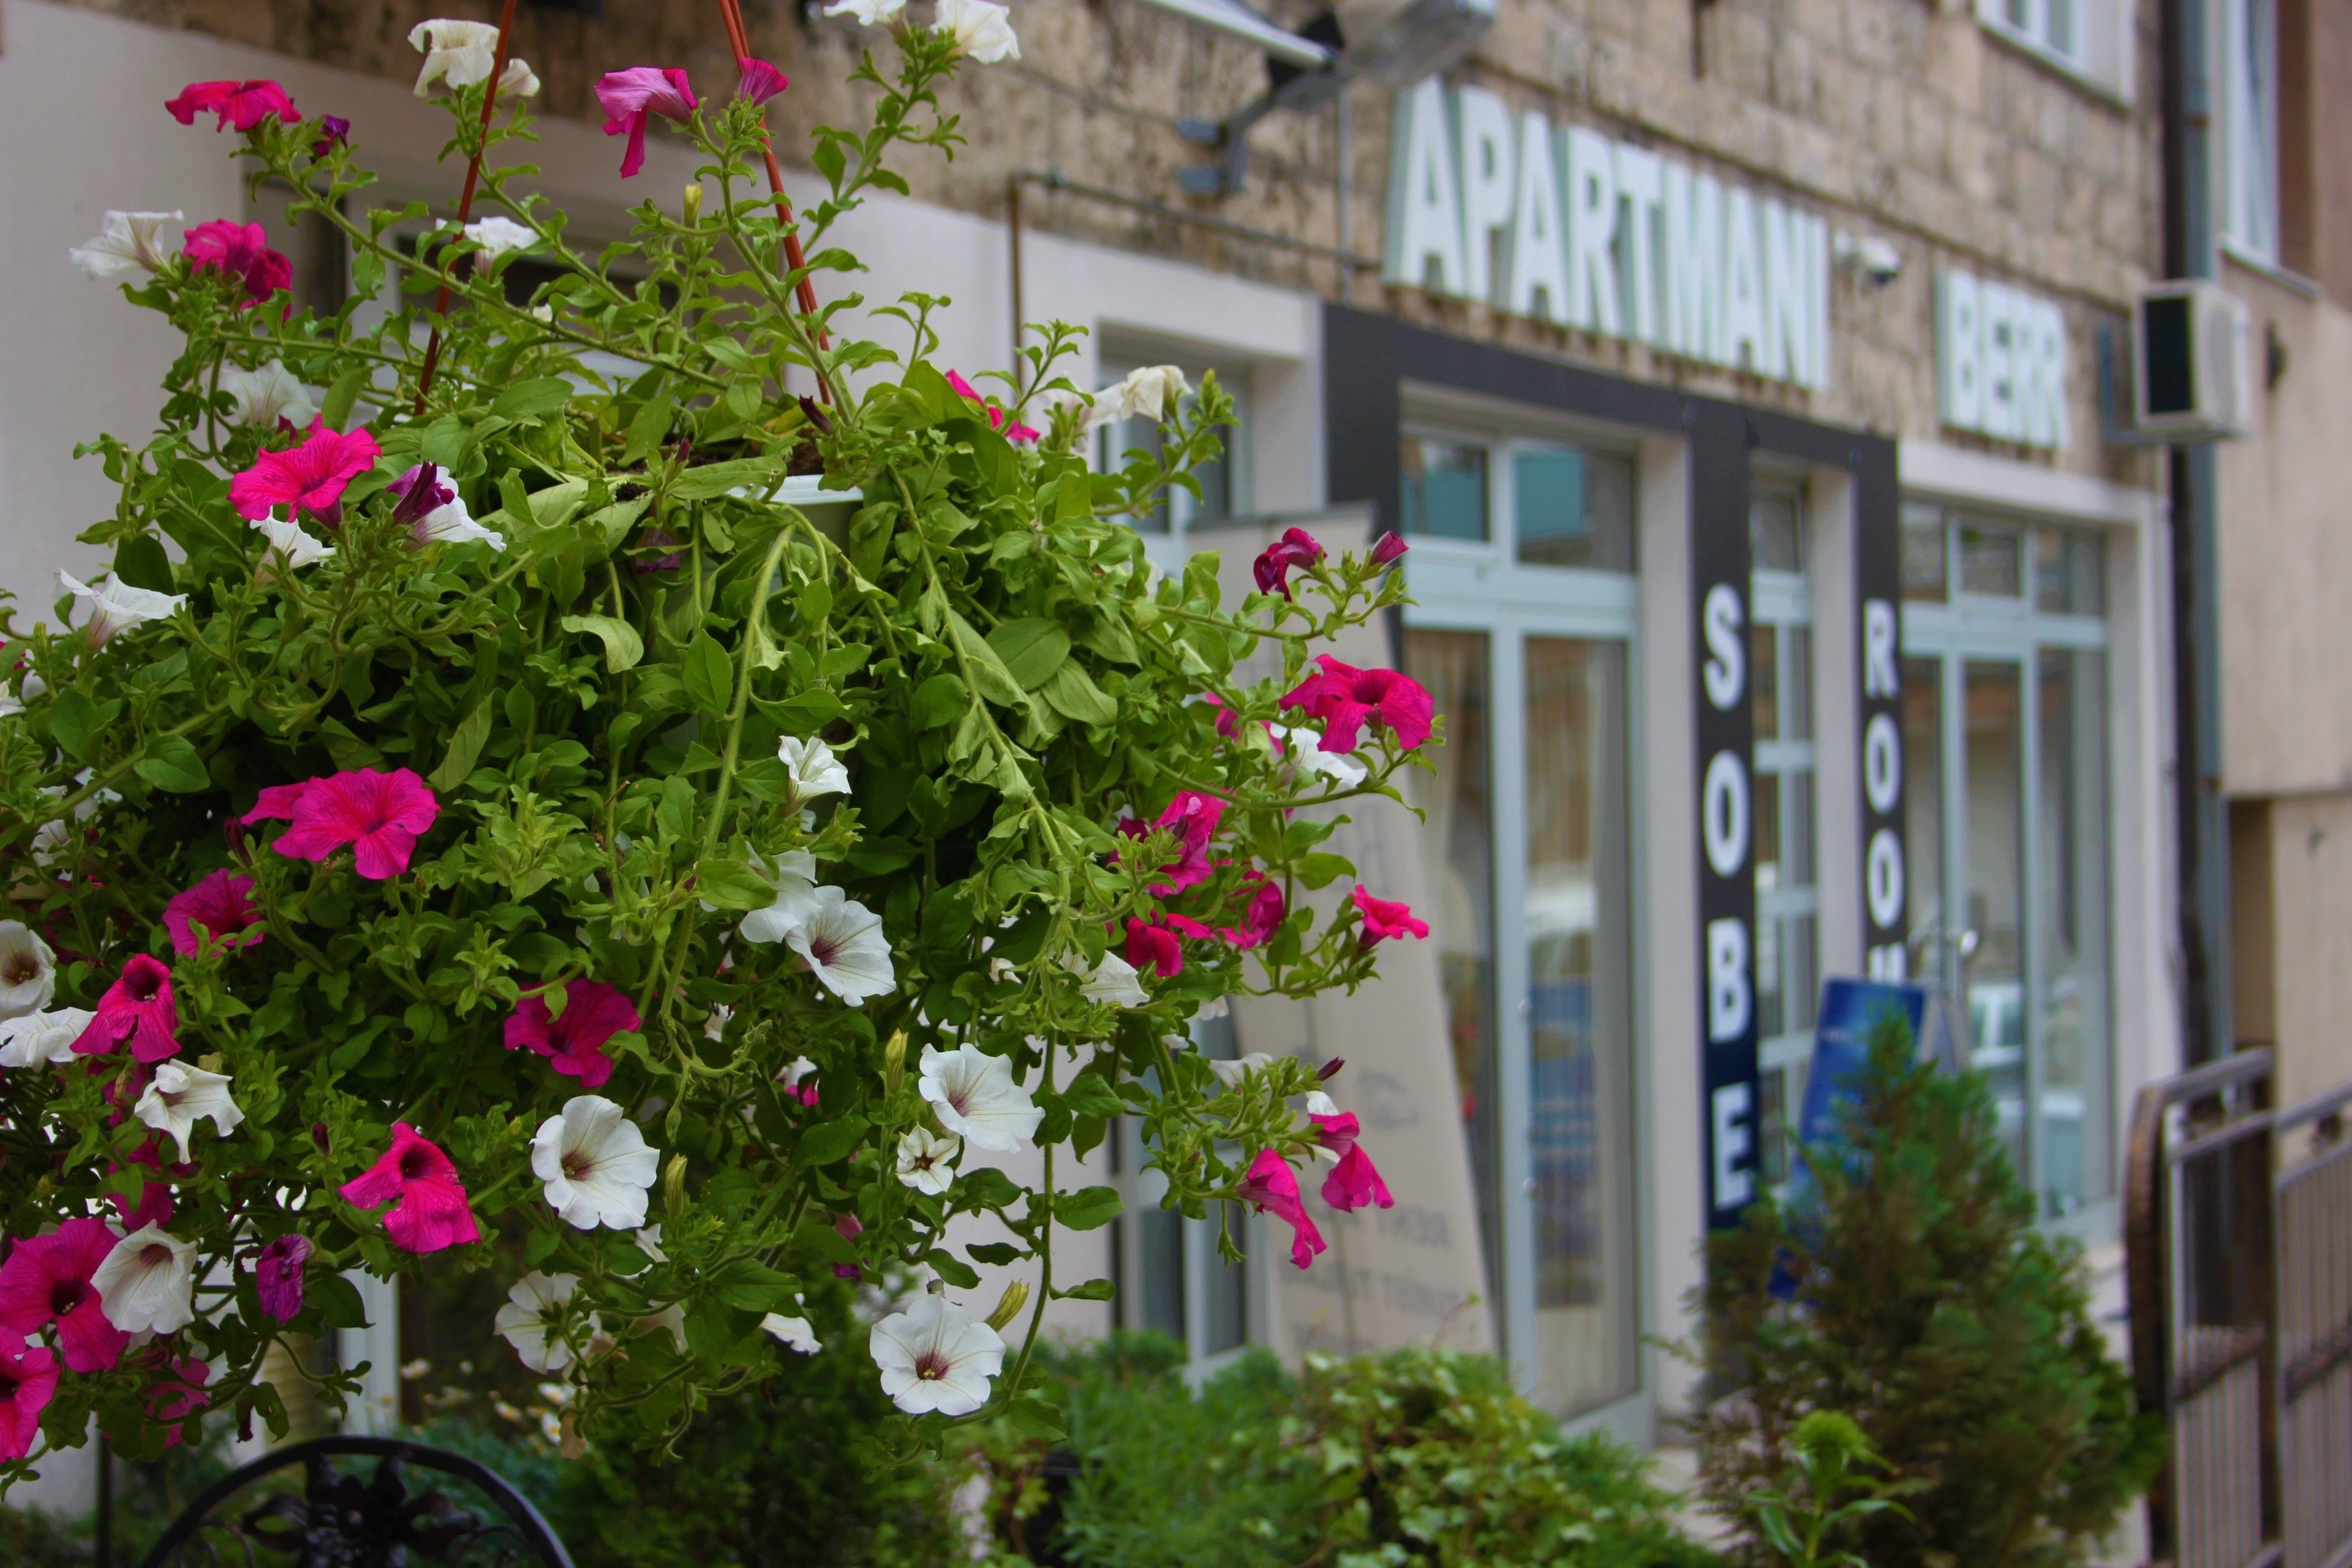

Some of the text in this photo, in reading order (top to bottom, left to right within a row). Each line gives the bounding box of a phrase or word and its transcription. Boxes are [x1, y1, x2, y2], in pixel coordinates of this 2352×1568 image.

[1383, 75, 1828, 392] APARTMANI
[1936, 268, 2073, 450] BERR
[1703, 584, 1754, 1212] SOBE
